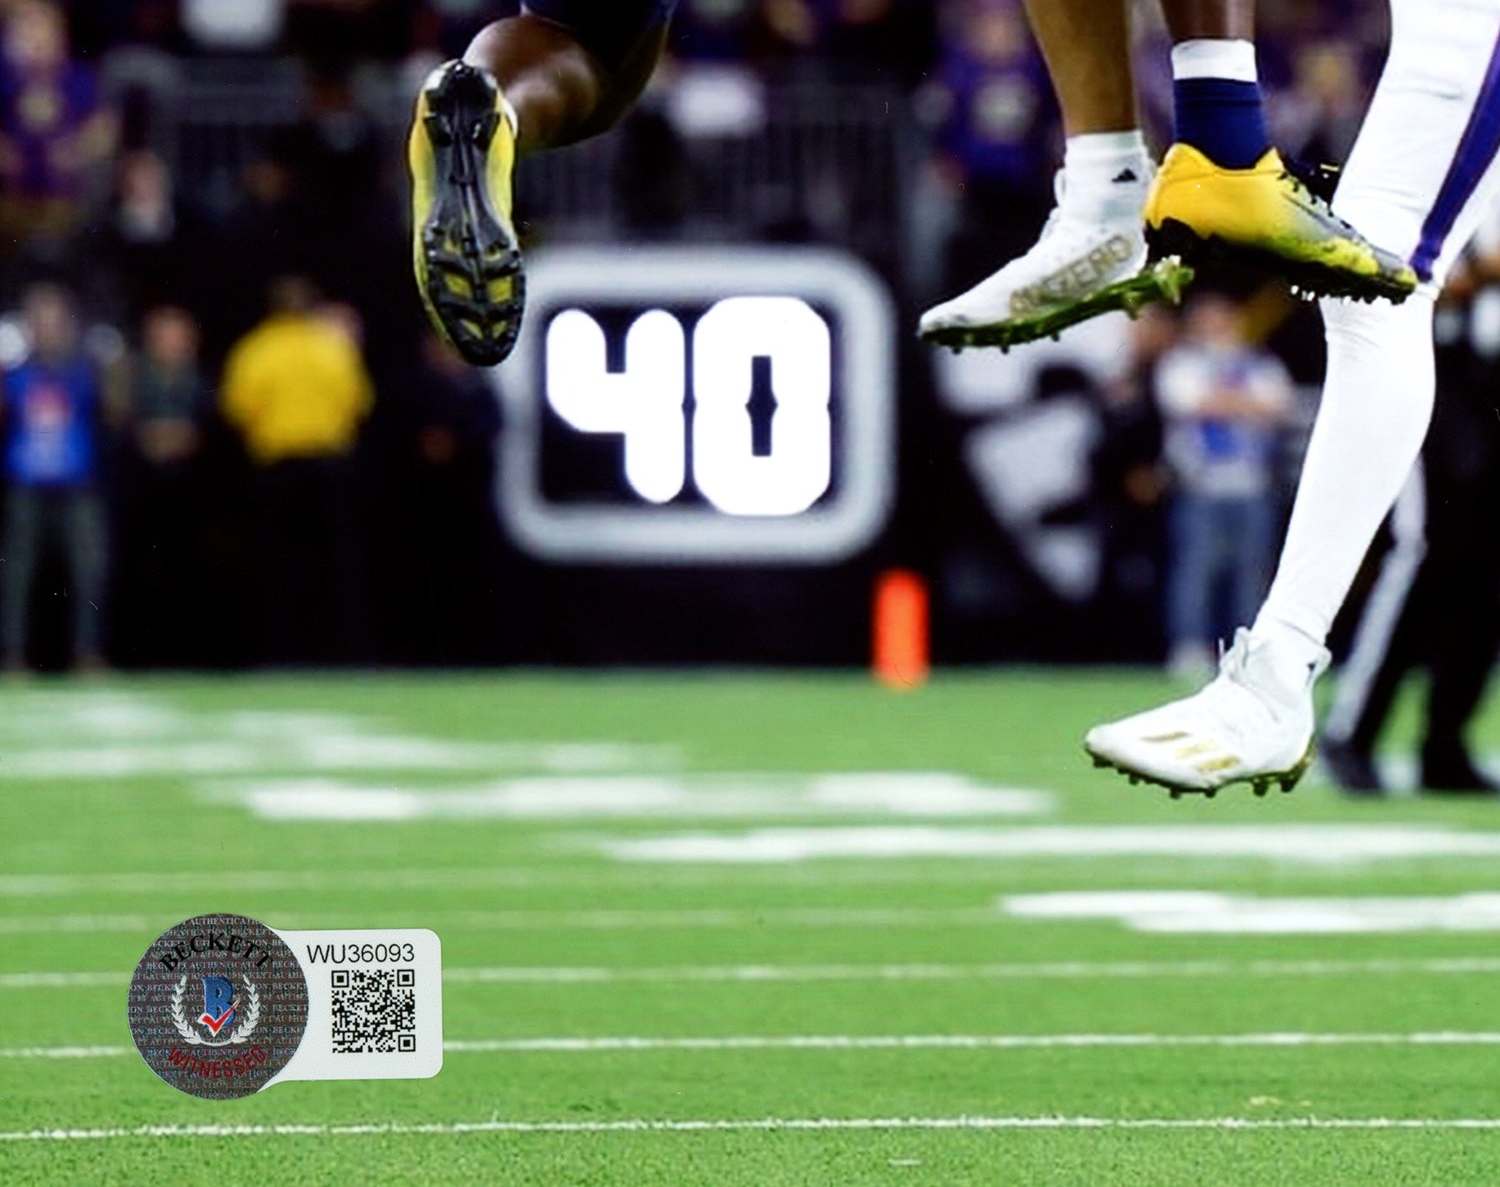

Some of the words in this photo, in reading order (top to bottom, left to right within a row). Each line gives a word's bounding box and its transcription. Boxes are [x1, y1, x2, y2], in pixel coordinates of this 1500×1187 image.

[546, 295, 832, 517] 40
[159, 932, 274, 972] BECKETT
[306, 943, 415, 964] WU36093
[167, 1046, 267, 1080] WITNESSED
